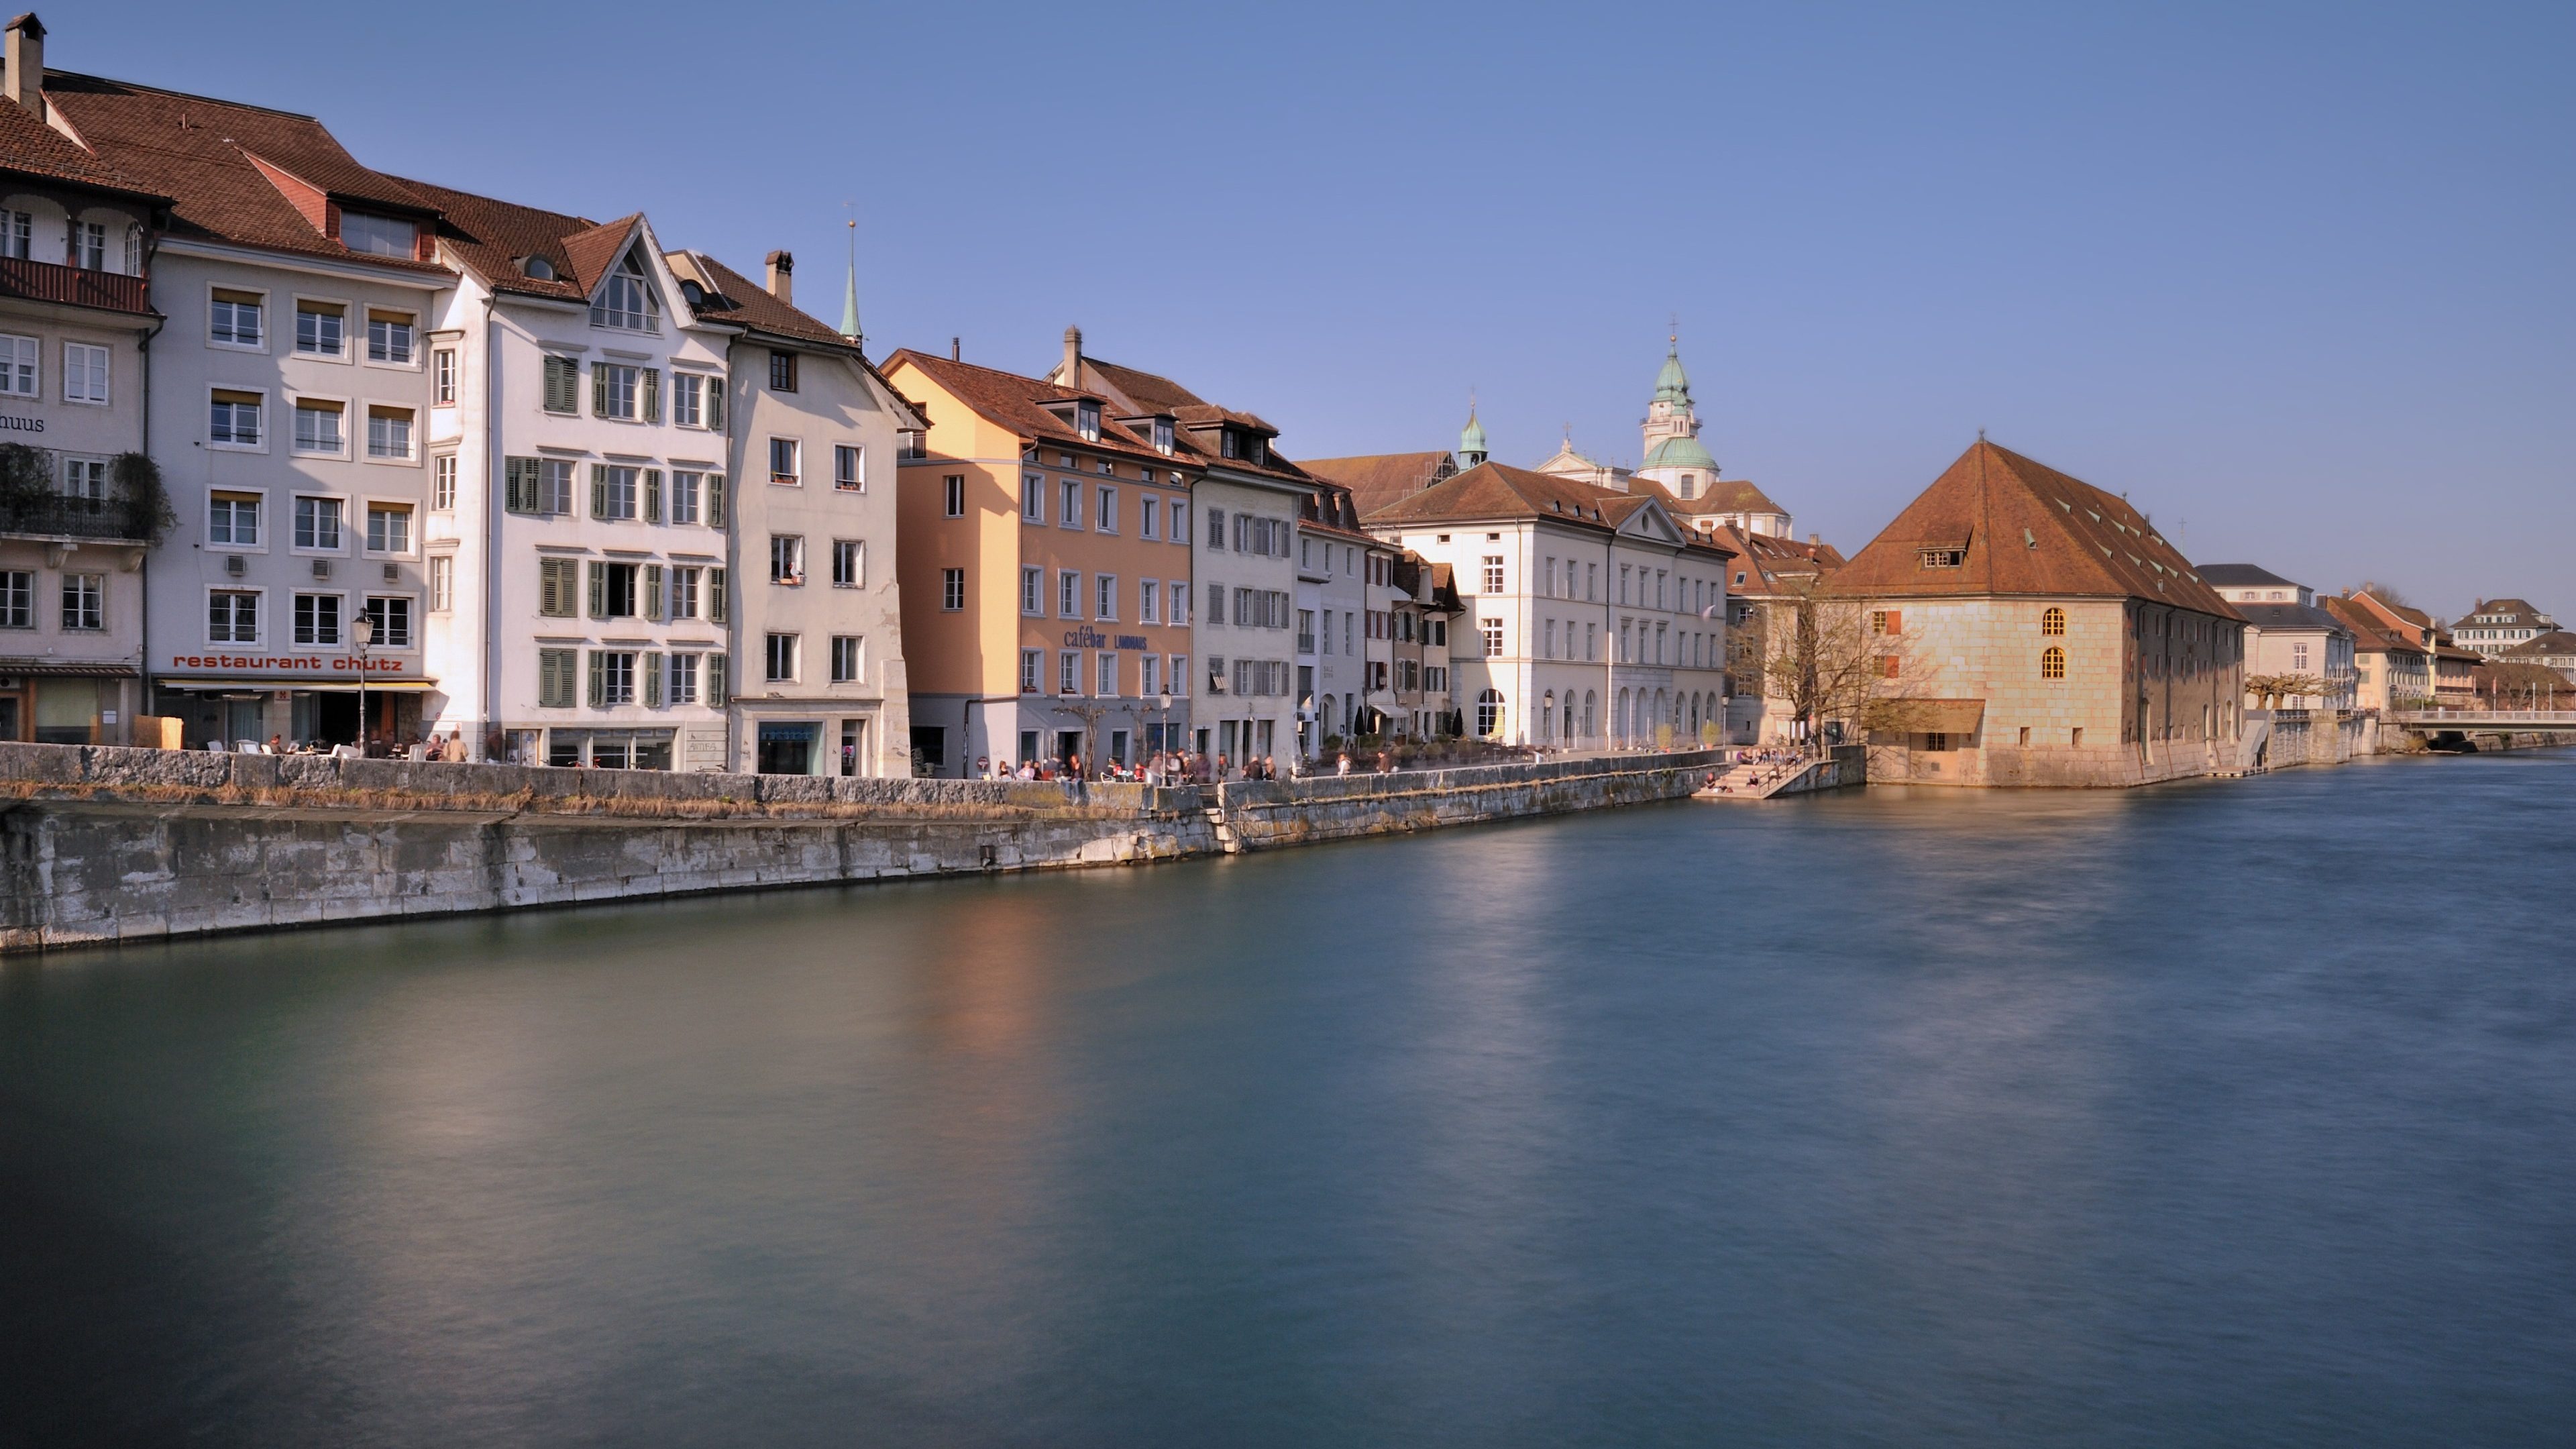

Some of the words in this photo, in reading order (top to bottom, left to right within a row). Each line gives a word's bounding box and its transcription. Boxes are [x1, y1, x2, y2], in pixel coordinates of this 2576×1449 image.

[1114, 635, 1147, 650] LANDHAUS
[173, 655, 321, 669] restaurant
[332, 655, 402, 672] chutz
